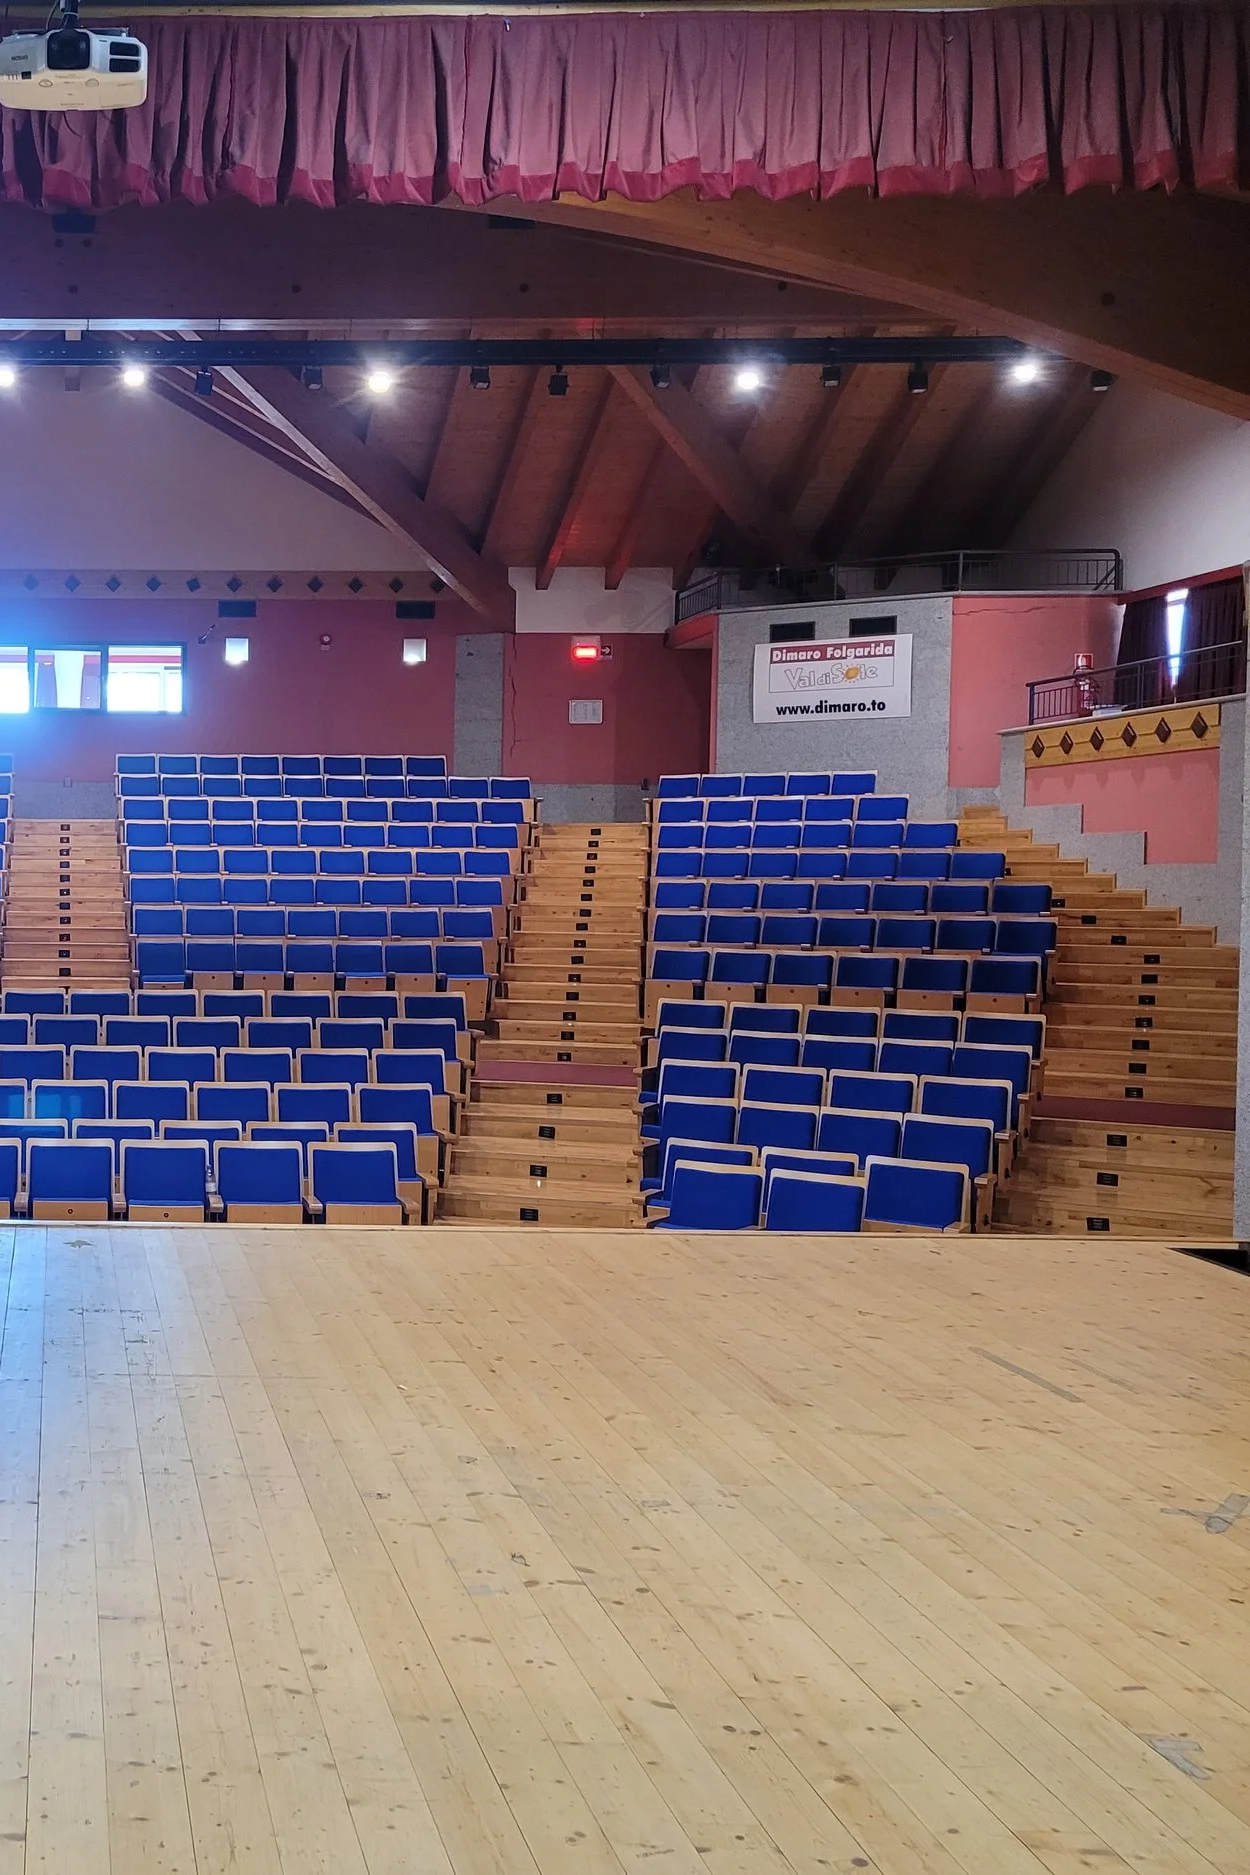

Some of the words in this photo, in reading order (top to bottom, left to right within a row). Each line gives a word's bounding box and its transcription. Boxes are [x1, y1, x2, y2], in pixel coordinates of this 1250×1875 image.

[772, 649, 821, 662] Dimaro
[827, 643, 893, 659] Folgarida
[784, 667, 816, 689] Val
[817, 674, 830, 685] di
[831, 662, 878, 684] Sole
[776, 699, 886, 716] www.dimaro.to
